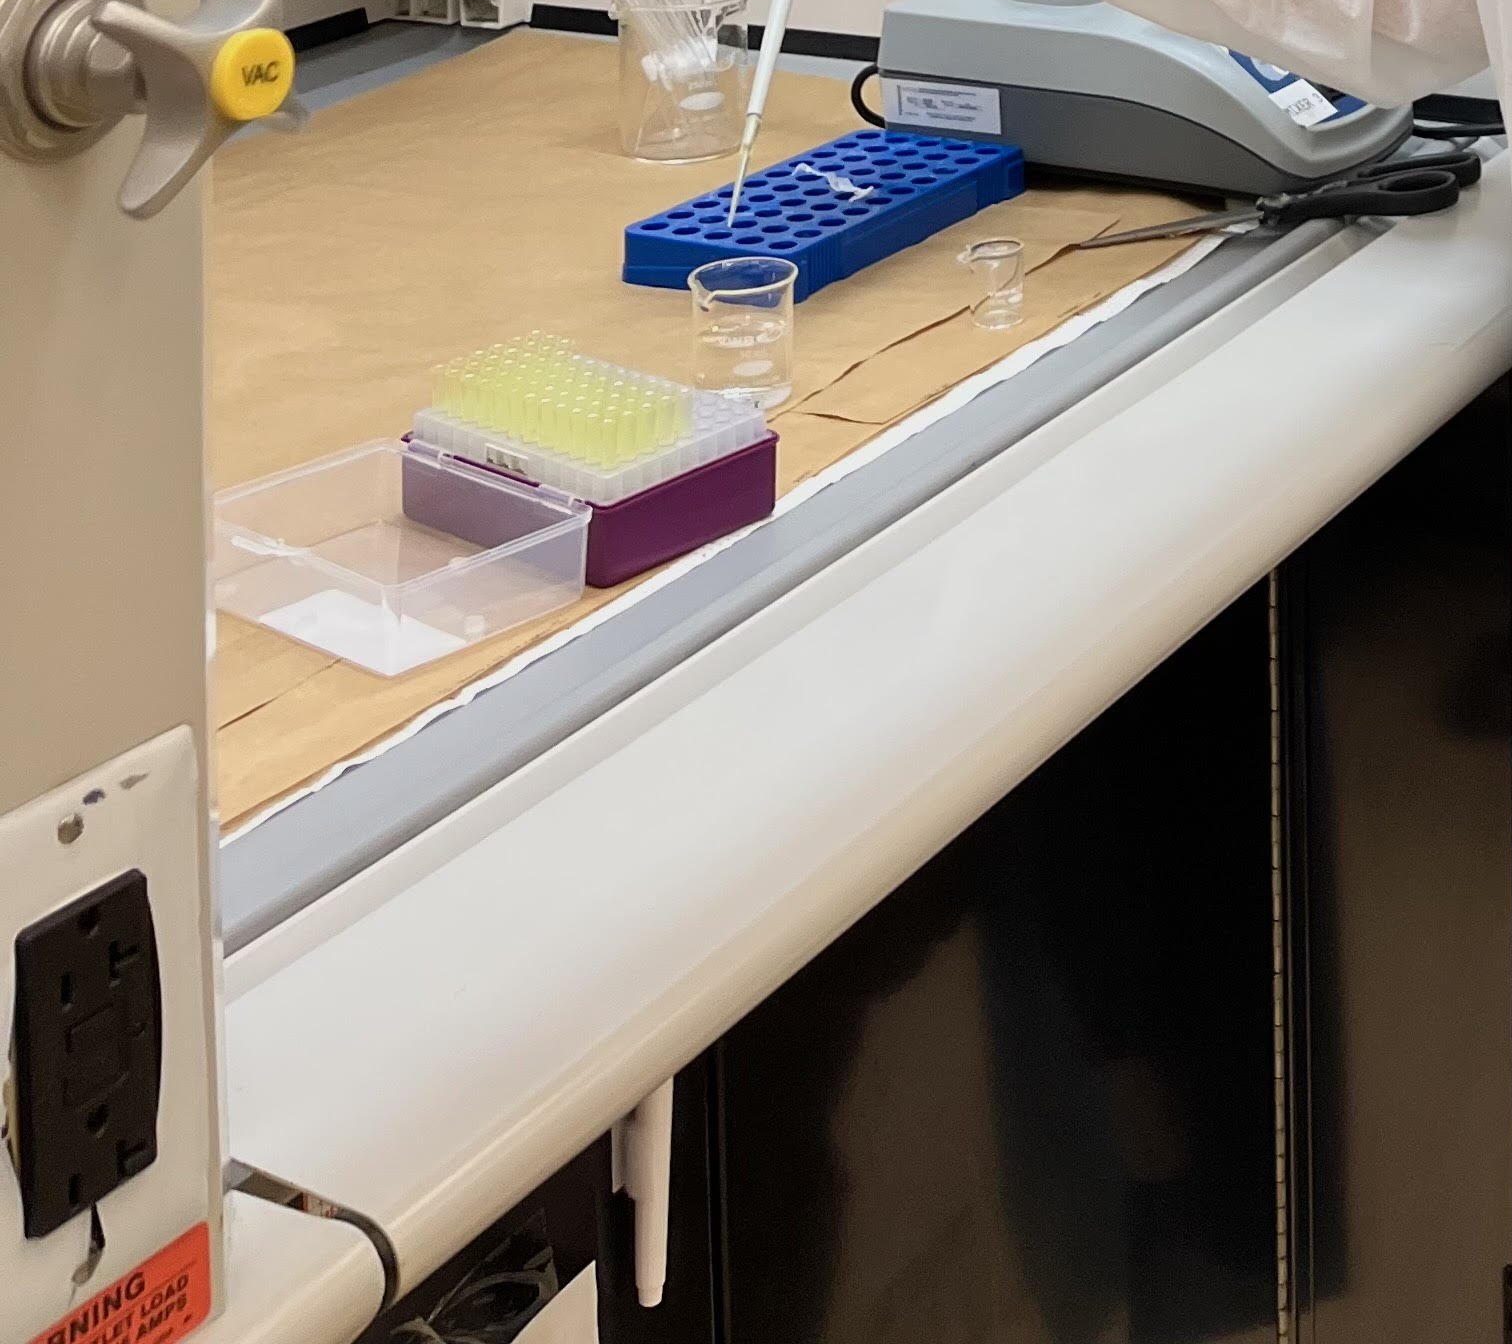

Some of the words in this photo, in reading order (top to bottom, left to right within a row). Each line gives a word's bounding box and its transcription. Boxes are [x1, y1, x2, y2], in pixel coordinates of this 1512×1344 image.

[240, 59, 281, 88] VAC
[136, 1293, 188, 1341] AMPS
[140, 1274, 190, 1318] LOAD
